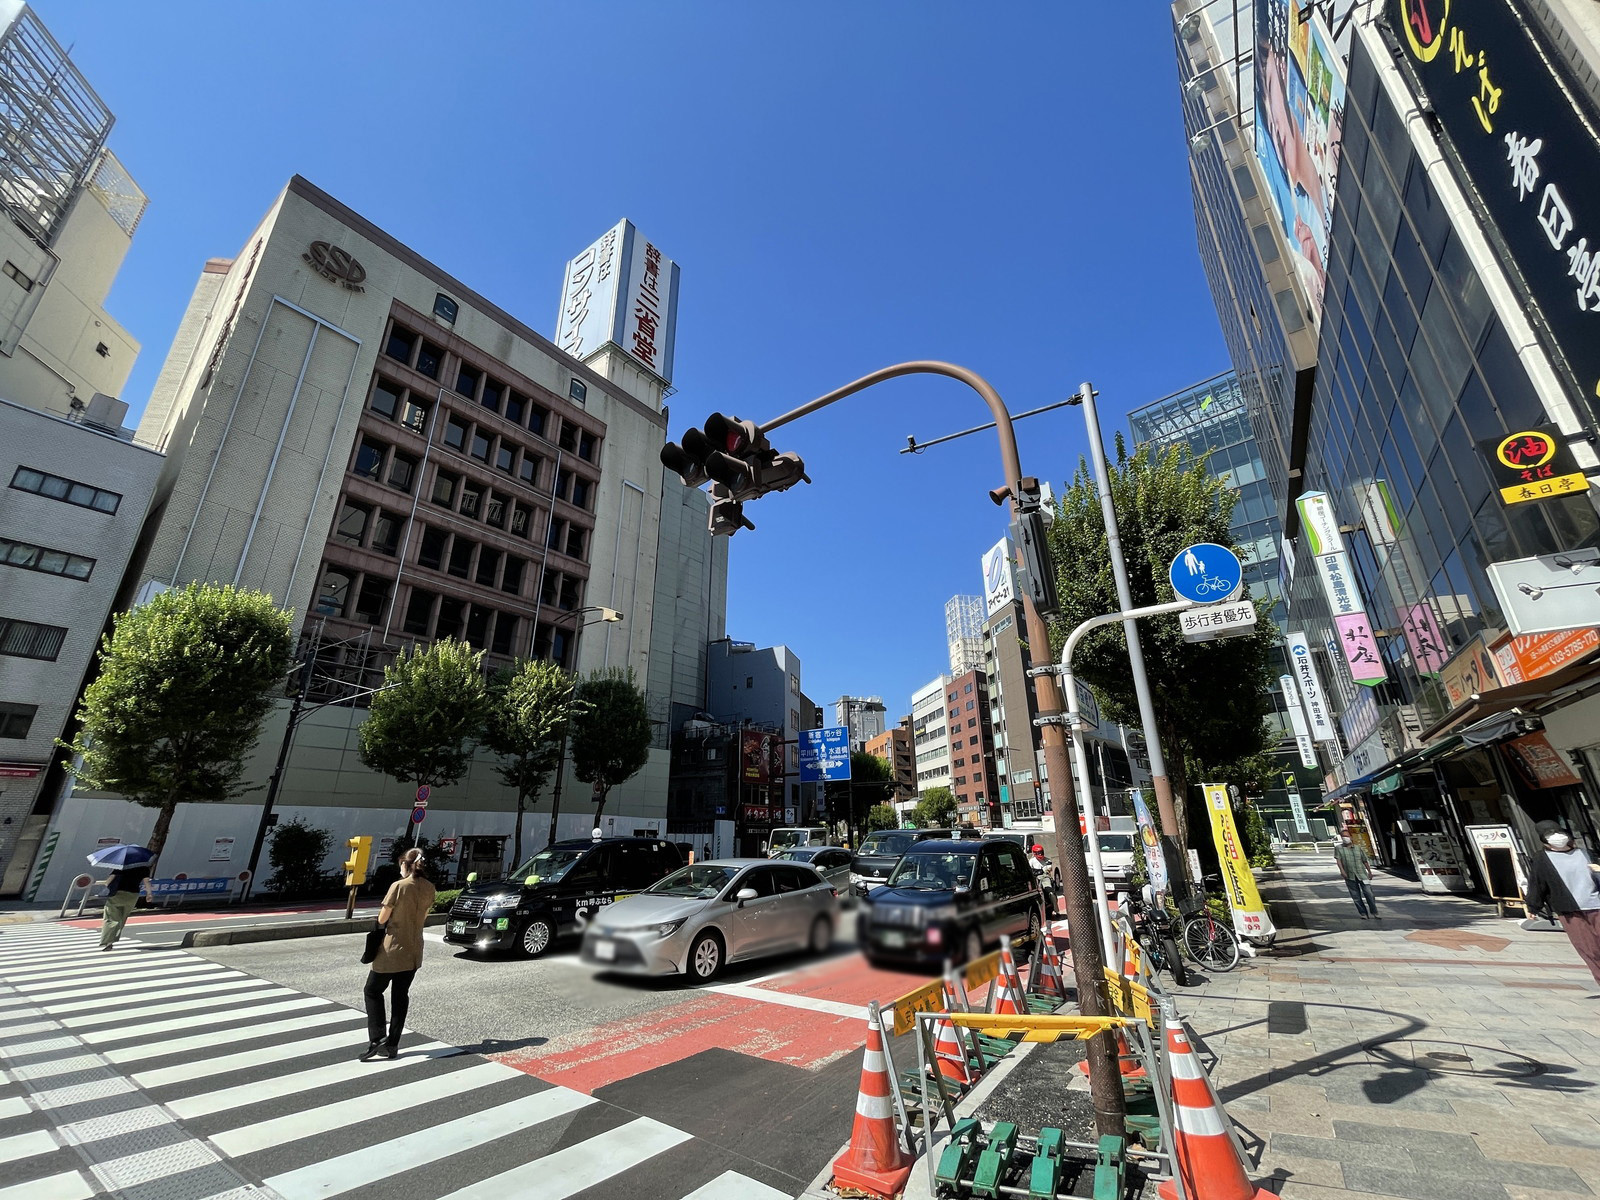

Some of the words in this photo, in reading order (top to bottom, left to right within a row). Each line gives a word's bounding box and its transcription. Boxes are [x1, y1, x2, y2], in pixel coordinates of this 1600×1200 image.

[1449, 26, 1502, 134] そば
[1504, 131, 1600, 312] 春日亭
[631, 241, 662, 369] 辞書は三省堂
[1505, 437, 1548, 464] 油
[1520, 464, 1553, 481] そば
[1519, 477, 1575, 499] 春日亭
[1184, 606, 1252, 630] 歩行者優先
[1297, 656, 1316, 699] 石井スポーツ
[1311, 701, 1325, 726] 神田本館
[828, 746, 848, 754] 水道橋
